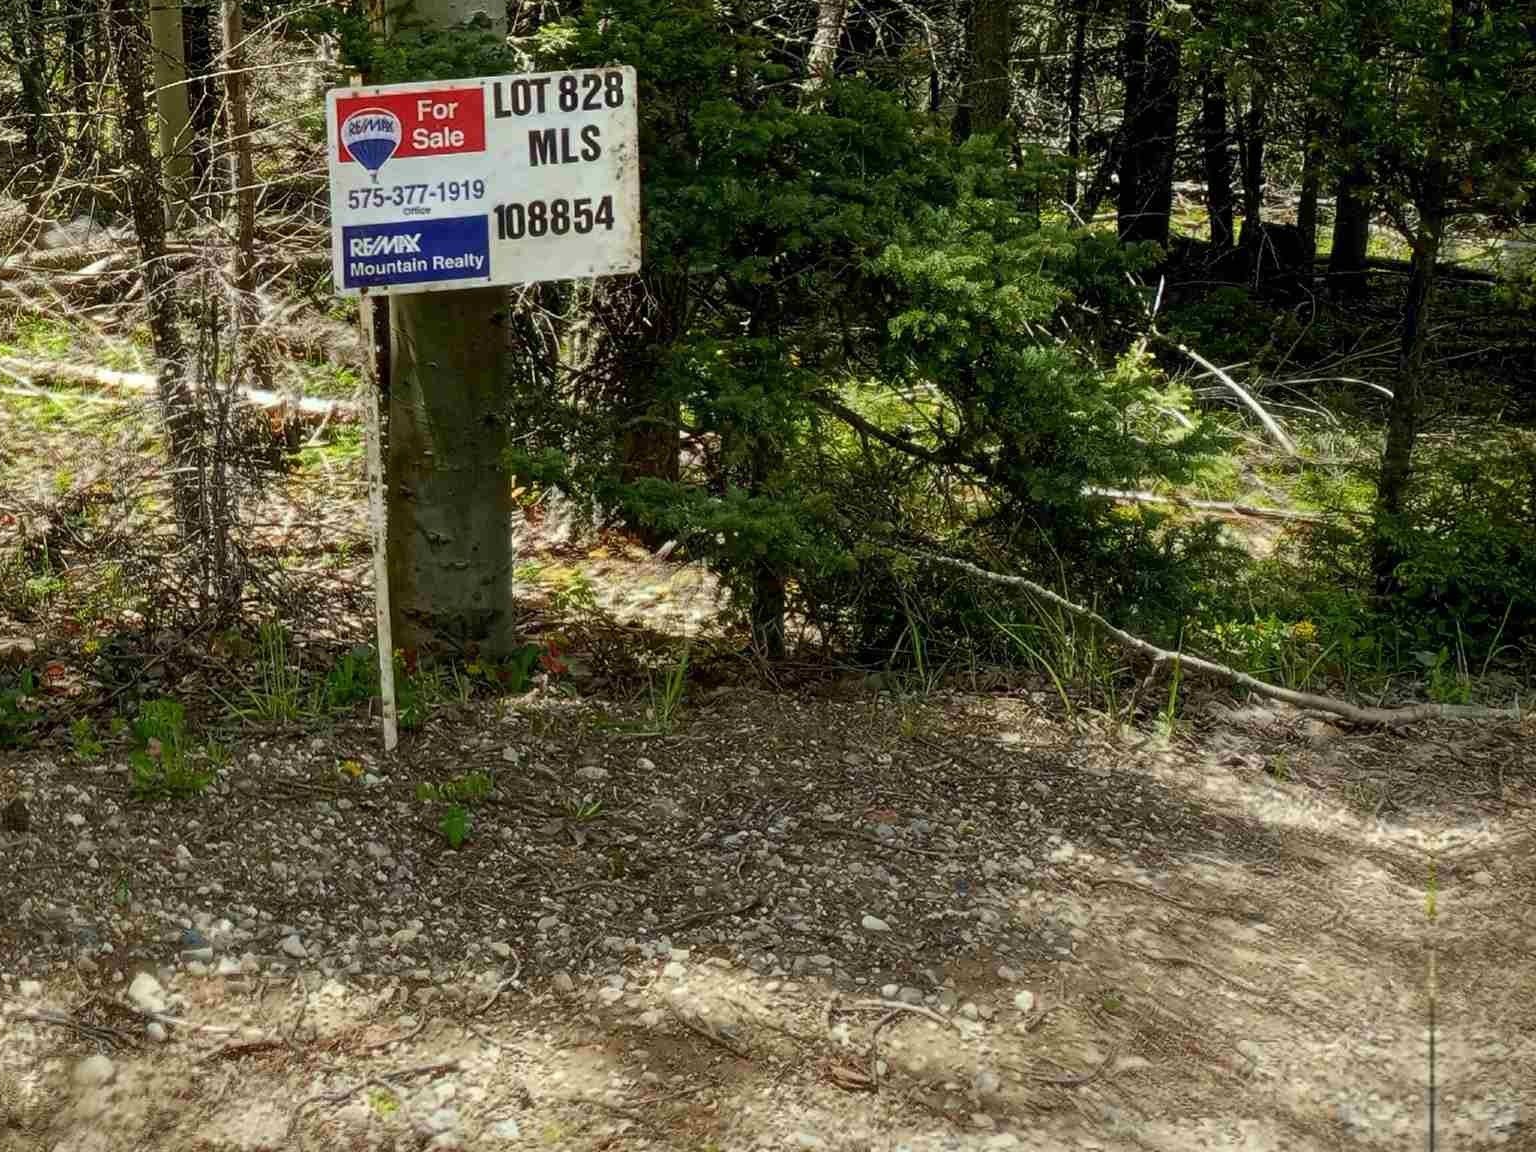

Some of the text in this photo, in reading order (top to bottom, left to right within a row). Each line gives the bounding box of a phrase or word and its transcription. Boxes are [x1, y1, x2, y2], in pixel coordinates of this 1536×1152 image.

[493, 71, 625, 119] LOT 828
[417, 100, 459, 122] For
[412, 126, 465, 150] Sale
[528, 124, 602, 167] MLS
[348, 179, 485, 210] 575-377-1919
[493, 195, 615, 241] 108854
[350, 233, 422, 258] RE/MAX
[350, 252, 485, 278] Mountain Realty
